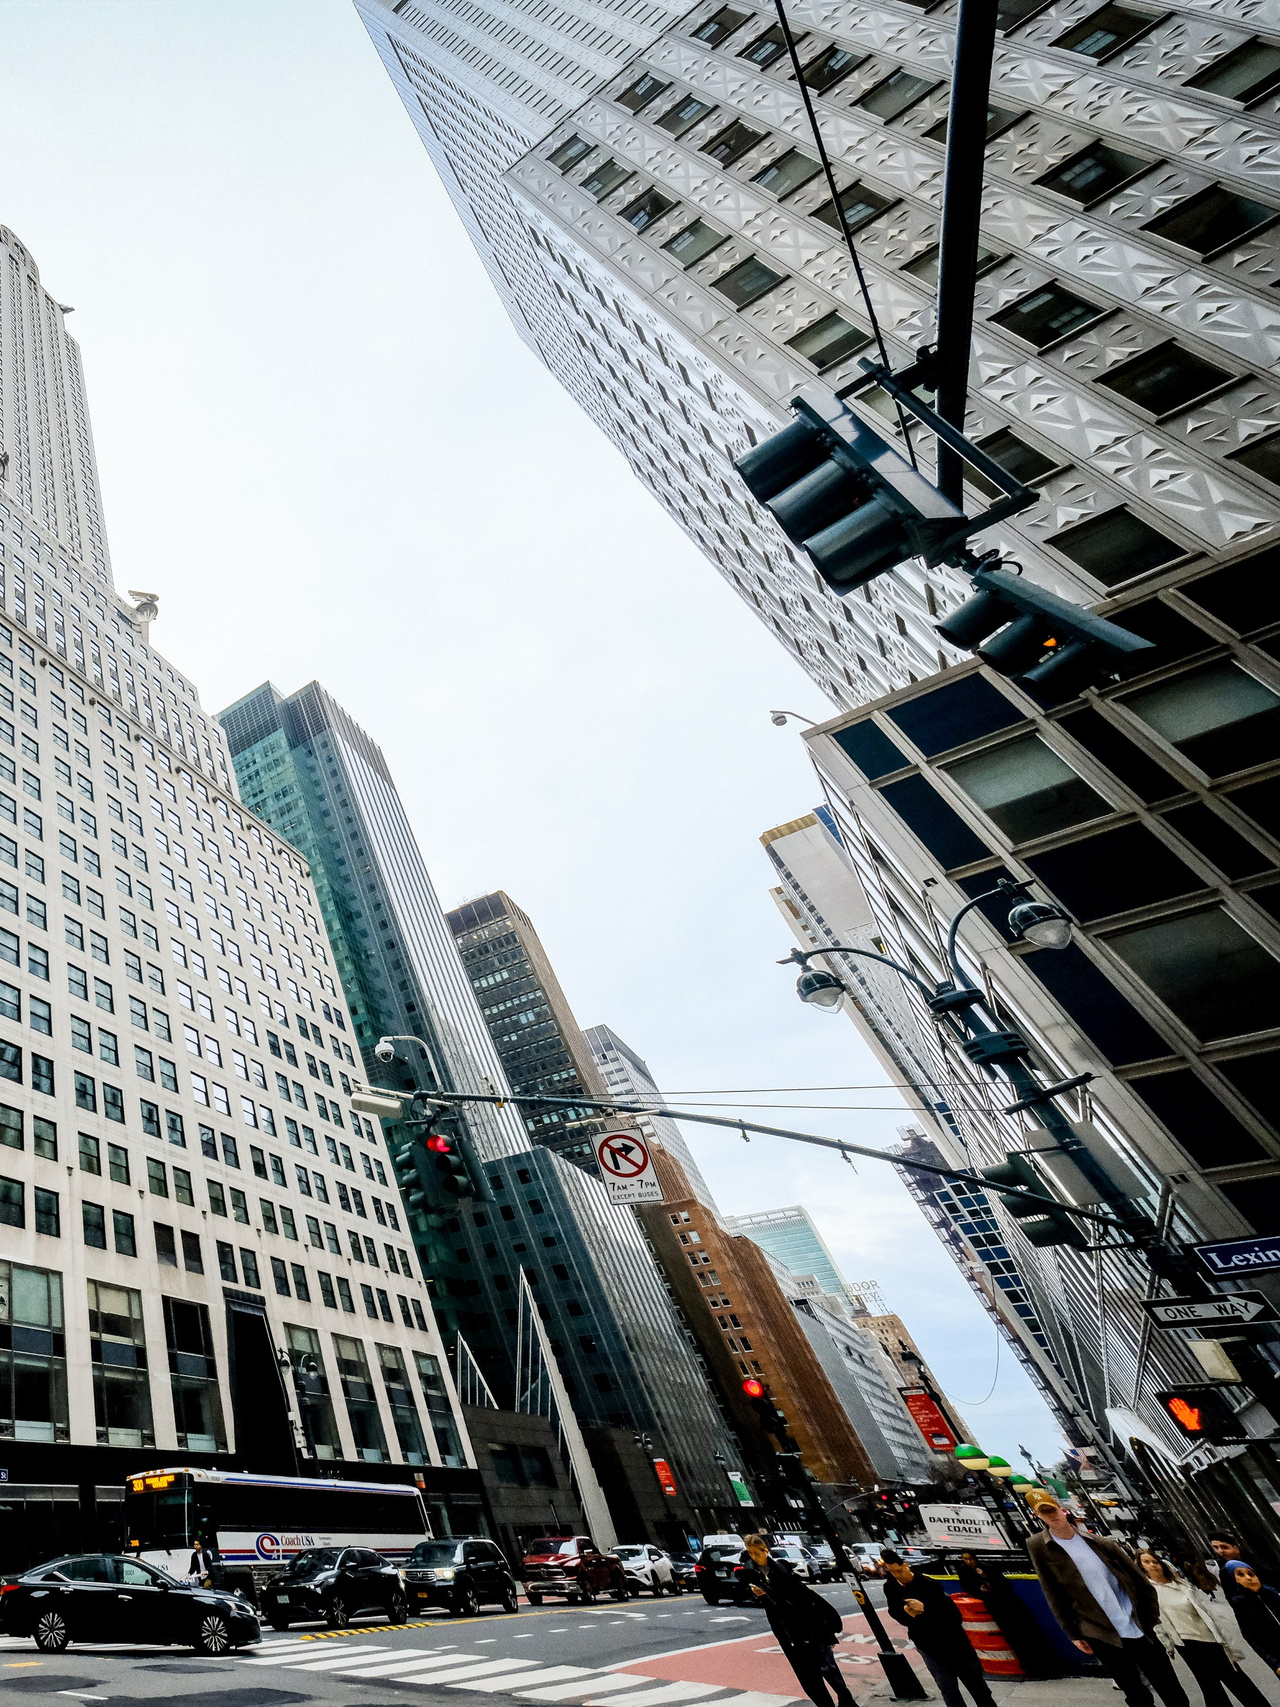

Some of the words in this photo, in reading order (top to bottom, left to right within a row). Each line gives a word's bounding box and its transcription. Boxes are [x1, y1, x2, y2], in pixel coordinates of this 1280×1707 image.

[609, 1182, 628, 1192] 7AM
[636, 1179, 657, 1189] 7PM
[612, 1193, 636, 1201] EXCEPT
[637, 1190, 659, 1198] BUSES
[1164, 1306, 1202, 1320] ONE
[1212, 1302, 1251, 1316] WAY
[132, 1479, 144, 1492] 300
[928, 1516, 995, 1527] DARTMOUTH
[947, 1525, 982, 1534] COACH
[280, 1535, 301, 1547] Coach
[301, 1535, 315, 1547] USA
